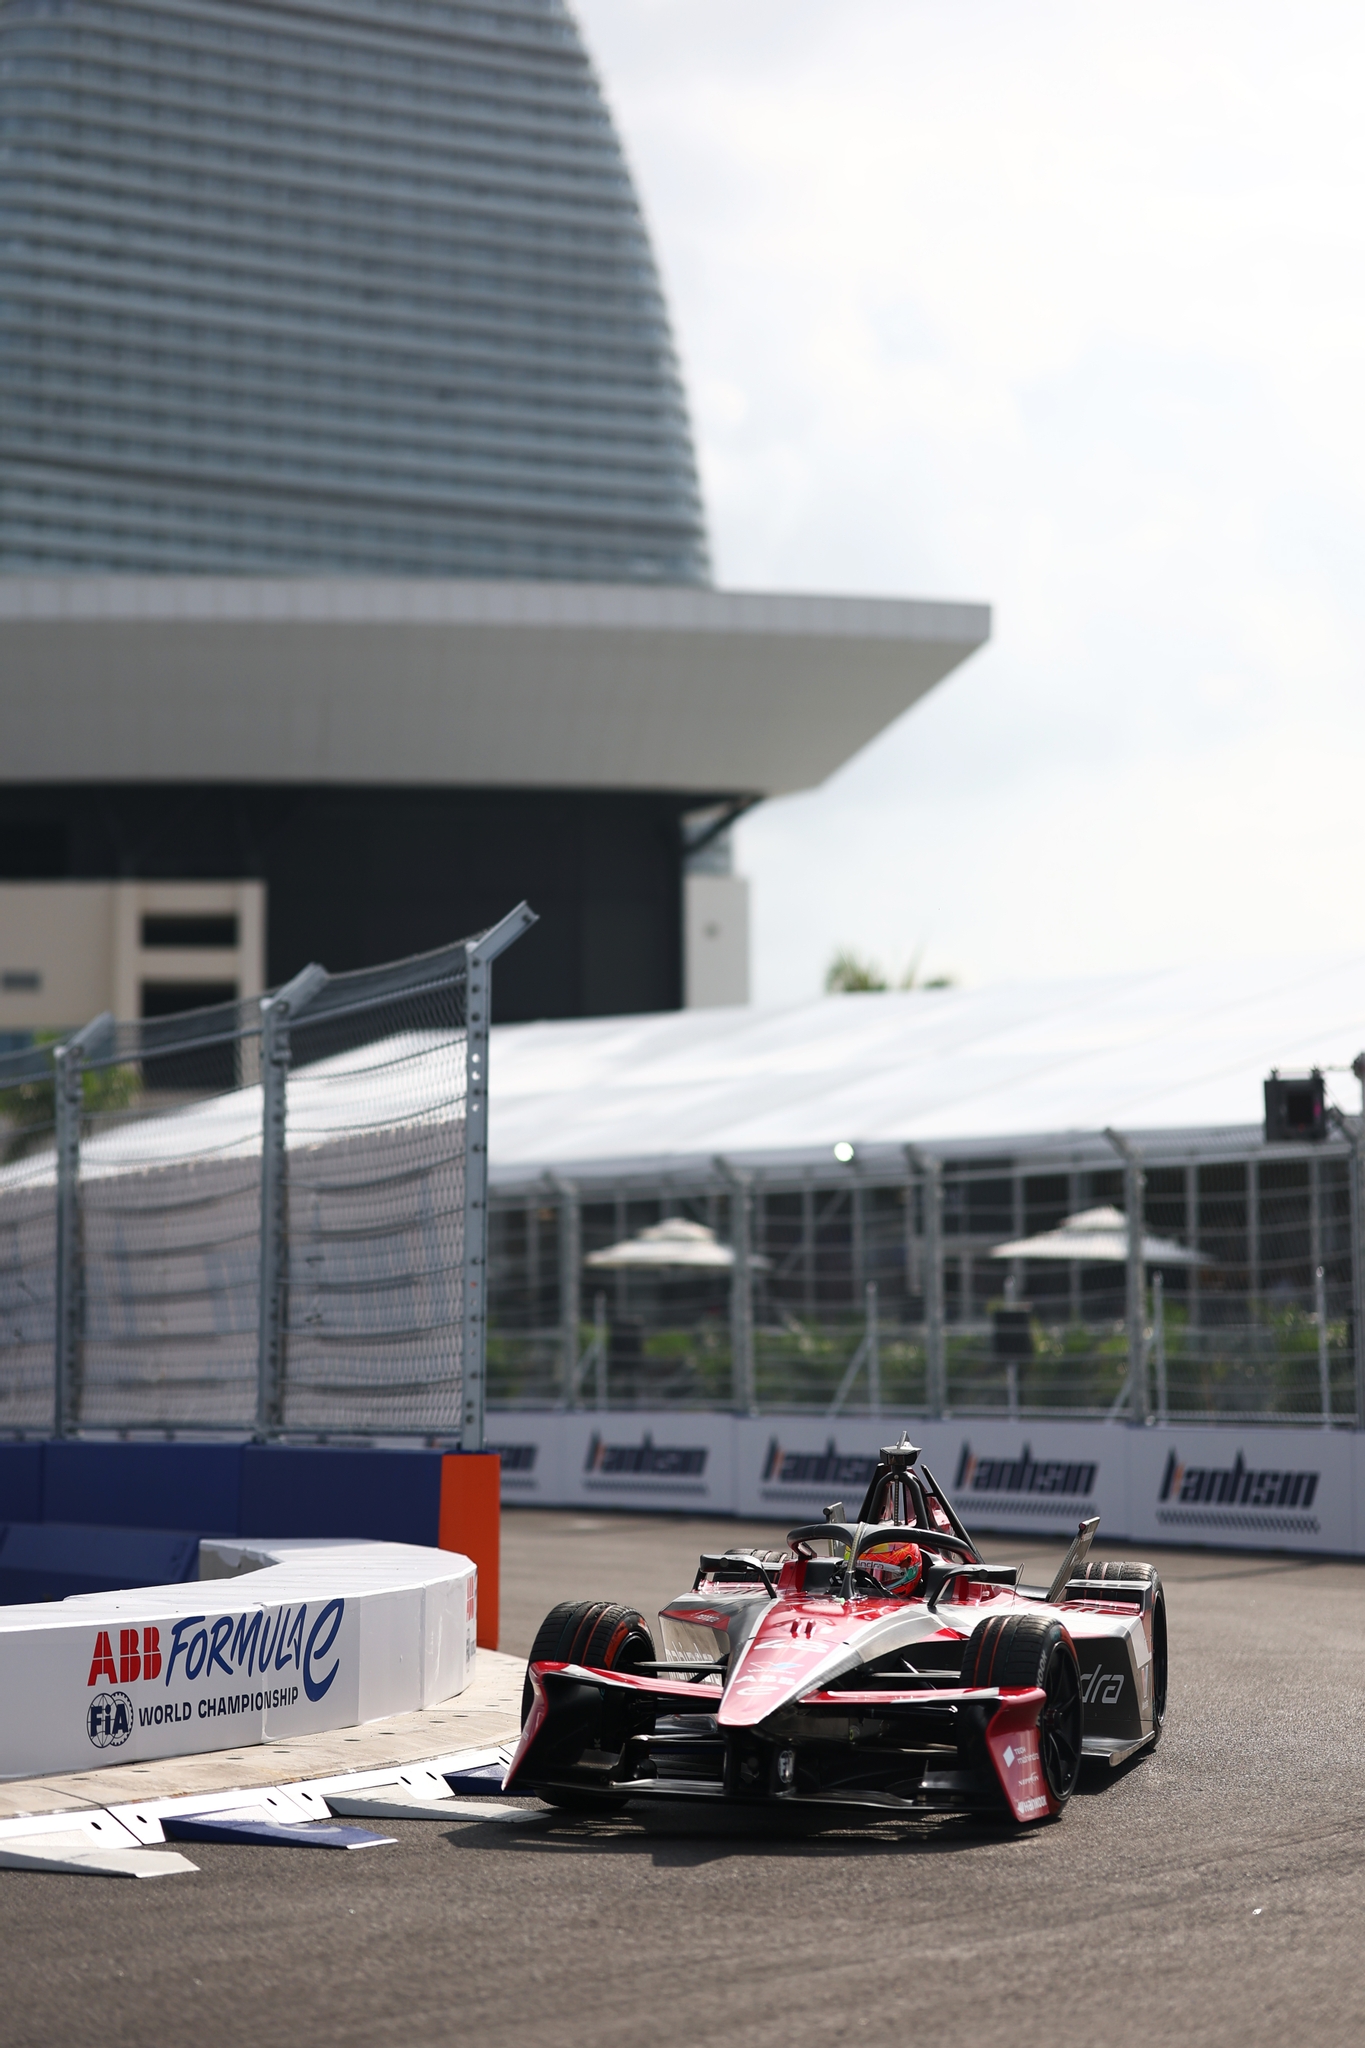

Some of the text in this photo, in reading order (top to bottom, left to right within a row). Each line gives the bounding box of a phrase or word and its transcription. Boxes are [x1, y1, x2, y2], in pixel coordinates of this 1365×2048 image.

[88, 1626, 162, 1686] ABB
[165, 1603, 307, 1687] FORMULA
[754, 1640, 830, 1654] 48
[734, 1675, 796, 1685] ABB
[138, 1686, 299, 1727] WORLD CHAMPIONSHIP
